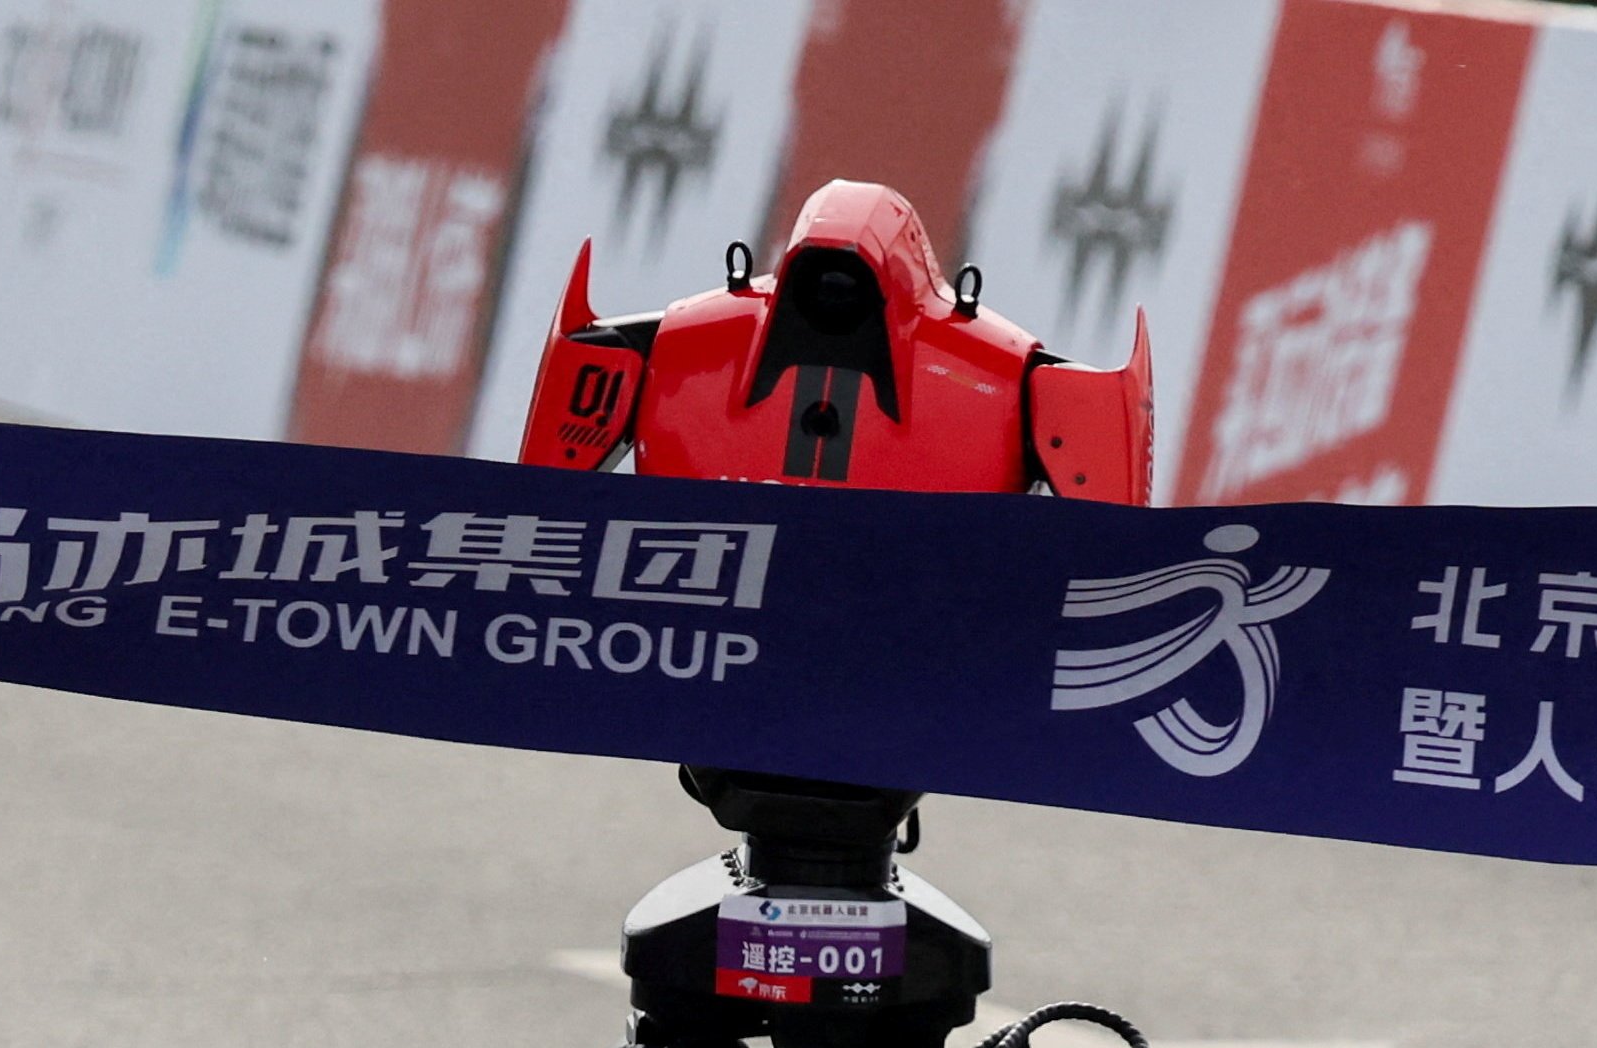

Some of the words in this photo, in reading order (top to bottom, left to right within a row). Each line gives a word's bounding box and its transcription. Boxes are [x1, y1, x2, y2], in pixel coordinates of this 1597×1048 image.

[569, 362, 625, 418] 01
[155, 595, 458, 658] E-TOWN
[484, 613, 759, 682] GROUP
[742, 940, 883, 975] 遥控-001
